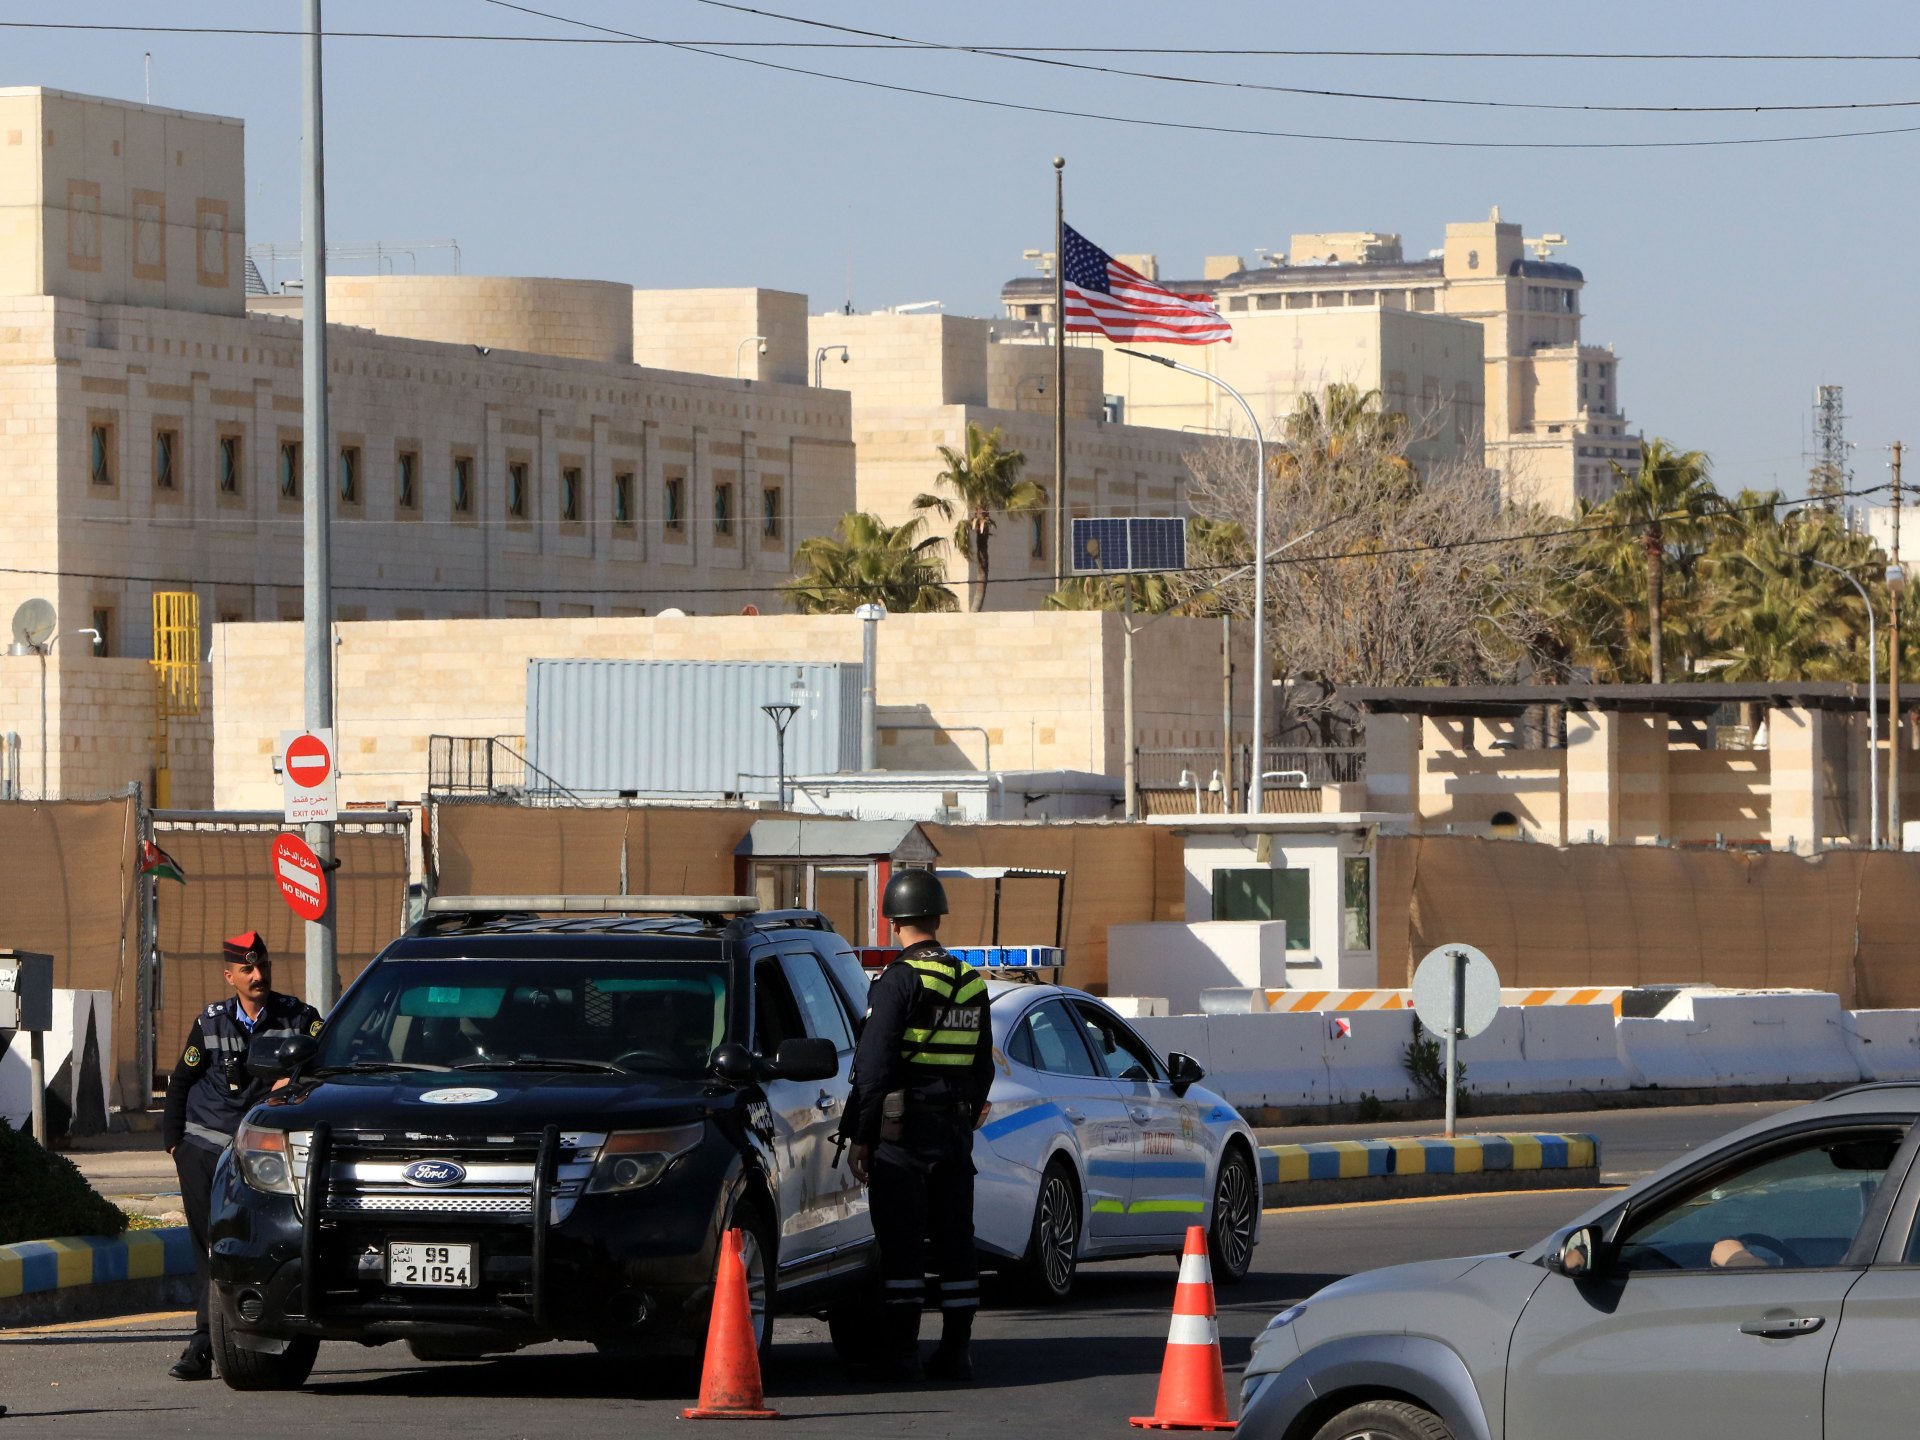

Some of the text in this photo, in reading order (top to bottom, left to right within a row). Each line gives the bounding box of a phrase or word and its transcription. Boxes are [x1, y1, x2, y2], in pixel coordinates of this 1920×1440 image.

[310, 795, 328, 805] مخرج
[278, 844, 317, 869] ممنوع الدخول
[282, 881, 320, 908] NO ENTRY
[1142, 1131, 1175, 1155] TRAFFIC
[415, 1164, 448, 1179] Ford
[425, 1247, 449, 1264] 99
[406, 1265, 468, 1284] 21054
